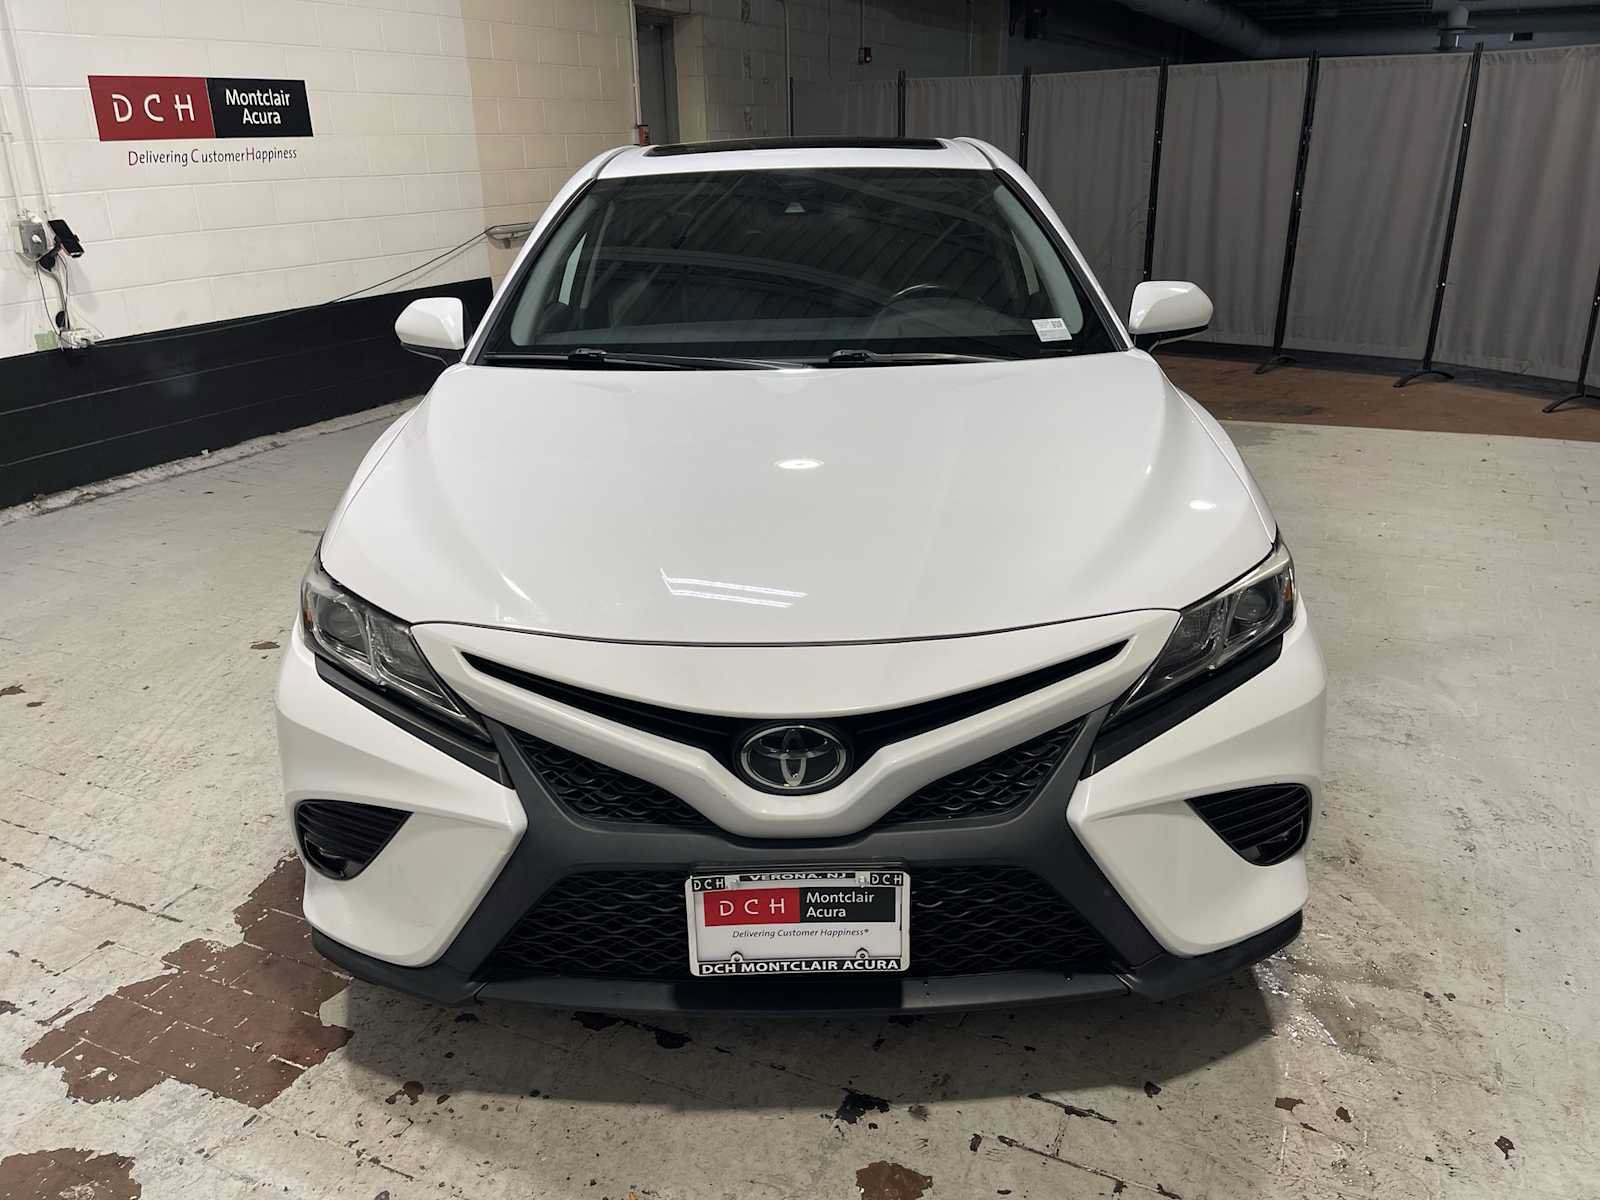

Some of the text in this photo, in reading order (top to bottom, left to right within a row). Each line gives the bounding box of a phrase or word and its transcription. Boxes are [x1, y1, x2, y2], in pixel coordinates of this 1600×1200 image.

[225, 88, 290, 106] Montclair
[242, 108, 281, 125] Acura
[128, 150, 188, 167] Delivering
[806, 891, 875, 903] Montclair
[806, 906, 846, 917] Acura
[732, 929, 775, 939] Delivering
[777, 929, 818, 937] Customer
[702, 960, 899, 974] DCH MONTCLAIR ACURA
